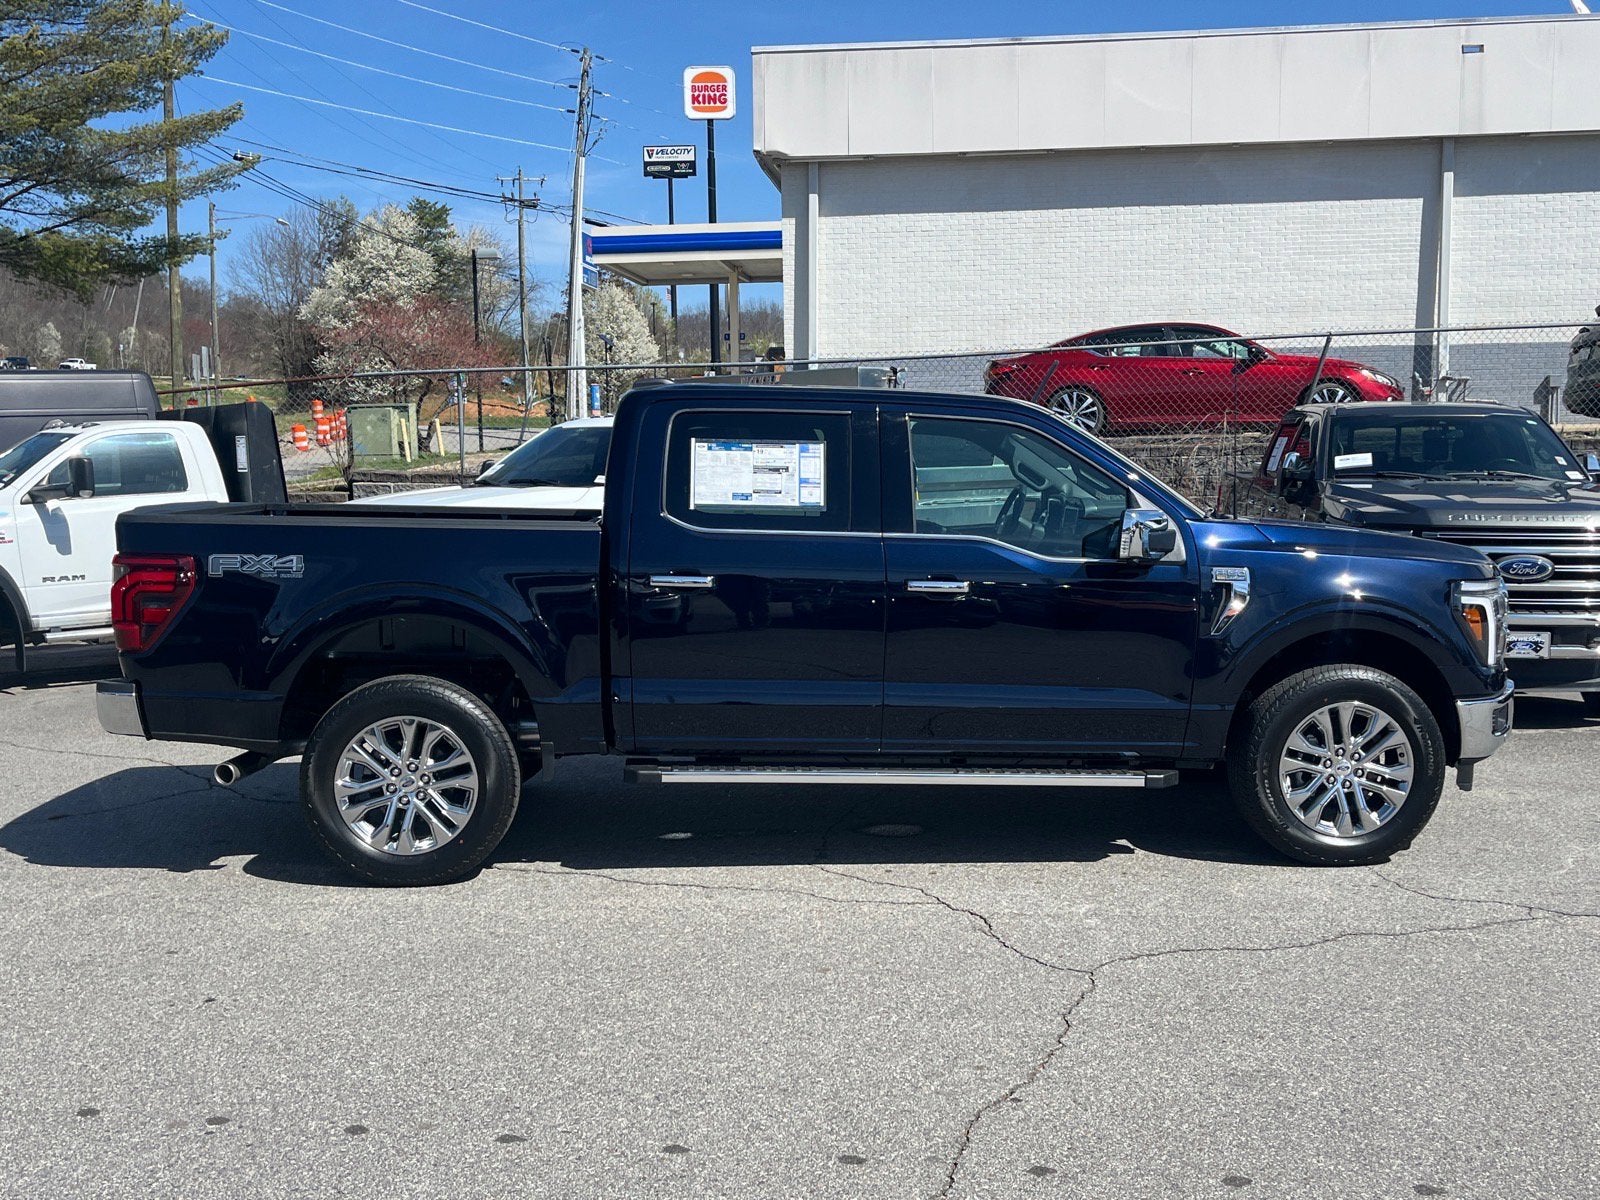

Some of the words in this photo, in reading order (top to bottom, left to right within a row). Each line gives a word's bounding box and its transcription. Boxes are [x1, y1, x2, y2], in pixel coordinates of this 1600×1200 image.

[691, 84, 727, 93] BURGER
[691, 93, 728, 105] KING
[208, 554, 304, 577] FX4
[1509, 562, 1540, 575] Ford
[42, 574, 86, 583] RAM
